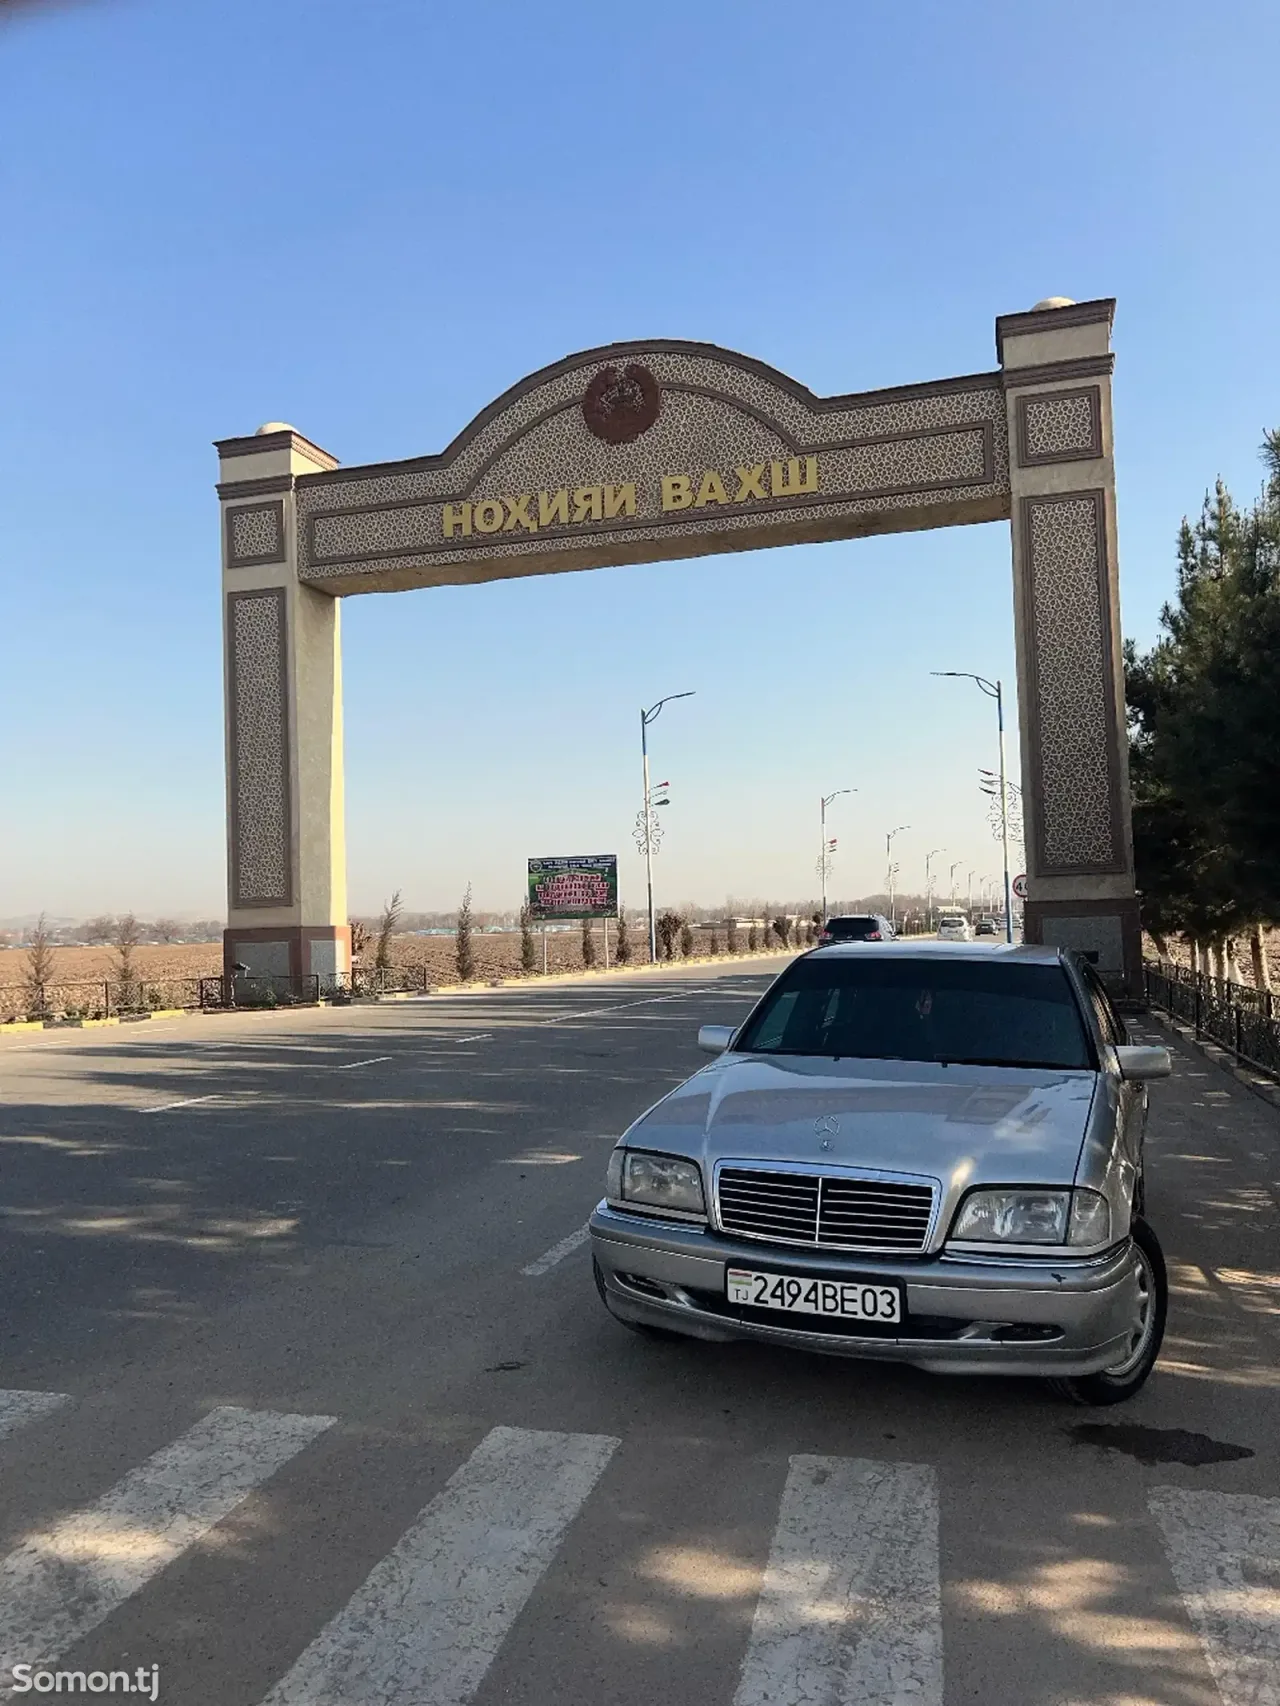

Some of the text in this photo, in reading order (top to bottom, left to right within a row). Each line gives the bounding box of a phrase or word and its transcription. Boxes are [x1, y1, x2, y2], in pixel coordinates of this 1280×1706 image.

[442, 456, 819, 538] НОҲИЯИ ВАХШ
[734, 1275, 896, 1319] TJ 2494BE03
